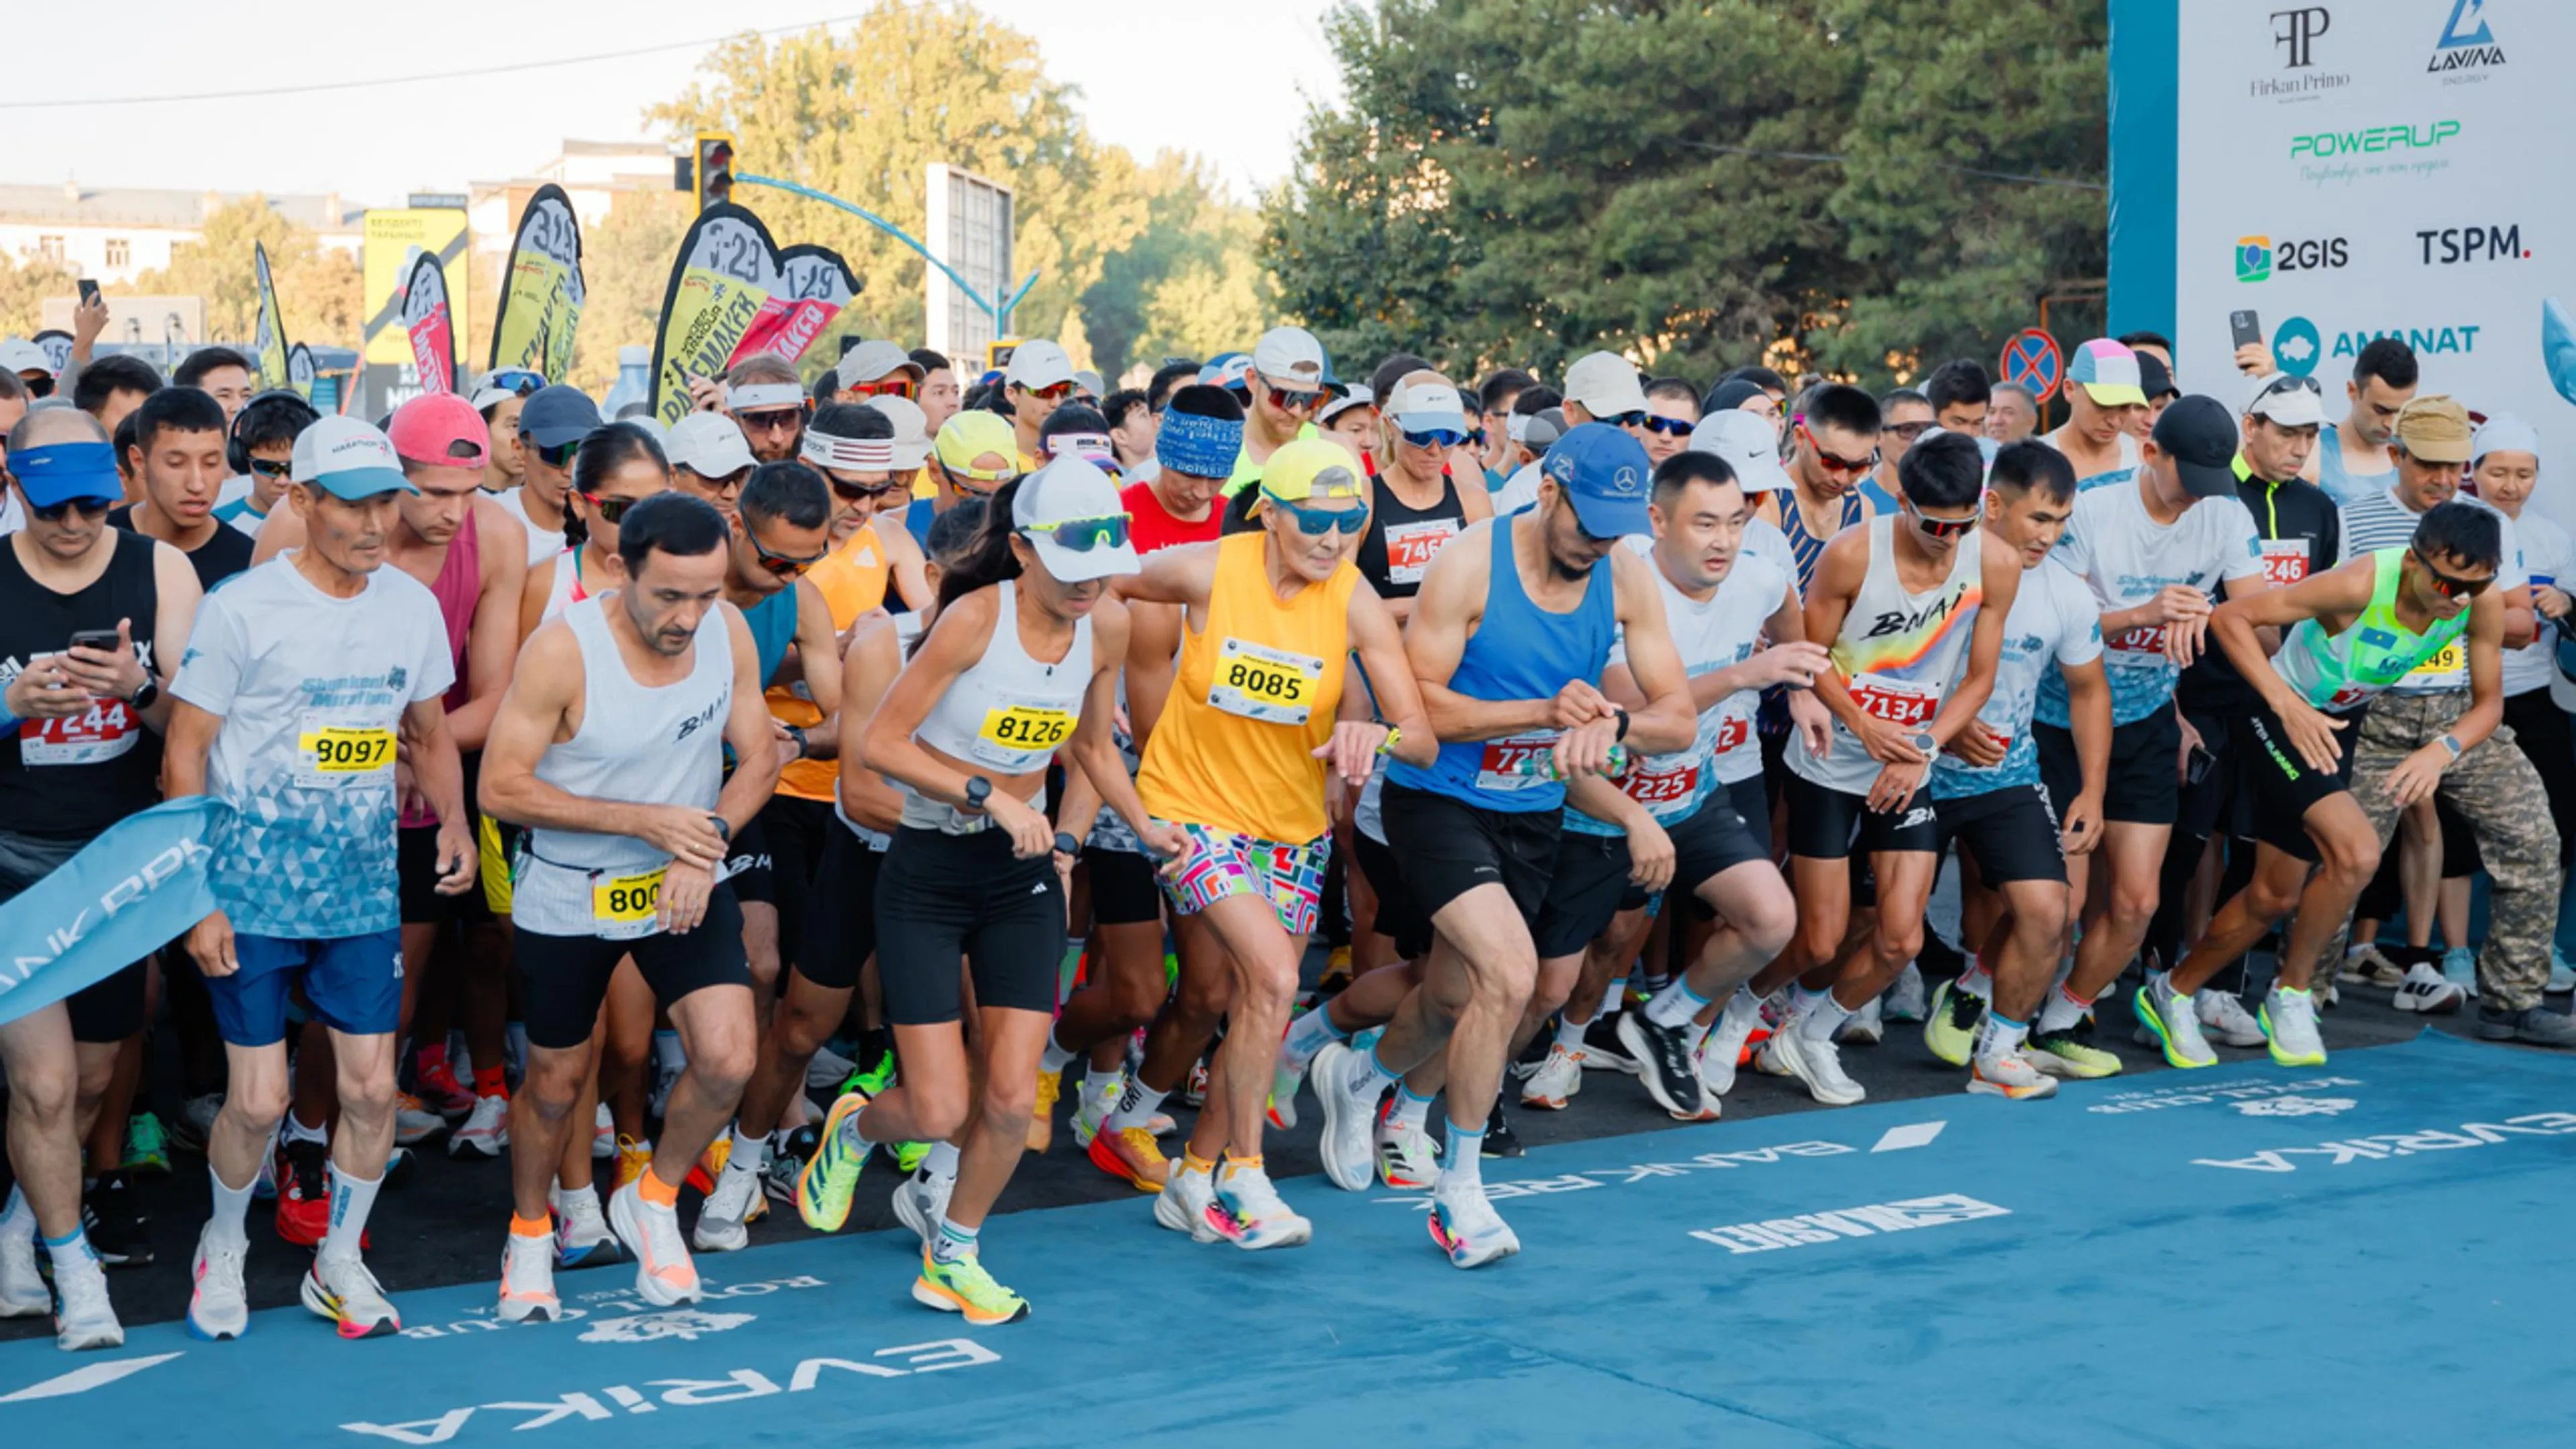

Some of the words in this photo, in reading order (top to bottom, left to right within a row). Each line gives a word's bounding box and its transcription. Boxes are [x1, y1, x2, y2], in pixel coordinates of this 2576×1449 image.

[2426, 46, 2507, 73] LAVINA
[2250, 77, 2300, 97] Firkan
[2303, 72, 2351, 91] Primo
[2290, 120, 2461, 159] POWERUP
[2278, 237, 2349, 272] 2GIS
[661, 289, 758, 425] PAEMAKER
[1399, 539, 1438, 562] 746
[2262, 559, 2302, 580] 246
[1229, 663, 1302, 700] 8085
[1861, 692, 1925, 720] 7134
[996, 716, 1066, 743] 8126
[316, 738, 388, 763] 8097
[610, 882, 661, 913] 800
[597, 1274, 829, 1312] ROYL
[400, 1307, 589, 1339] CUB
